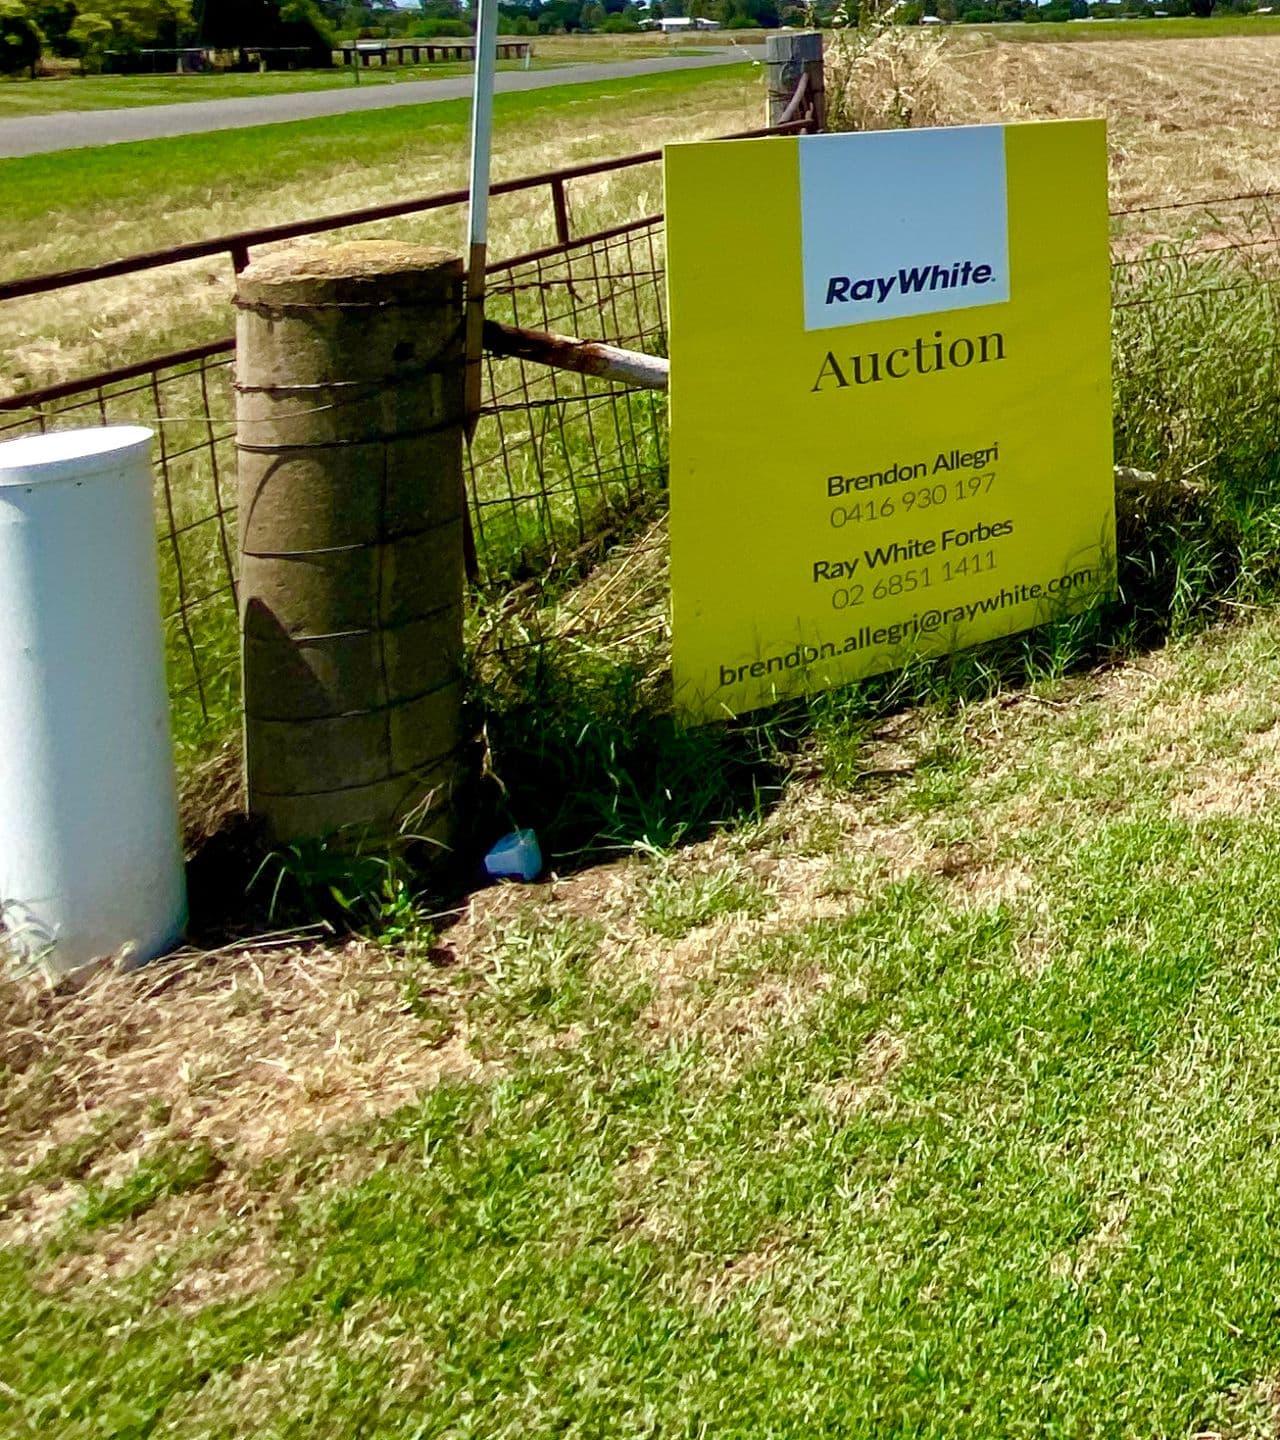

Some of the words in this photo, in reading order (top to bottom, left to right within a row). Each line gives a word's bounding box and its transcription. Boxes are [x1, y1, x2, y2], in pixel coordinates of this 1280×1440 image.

[811, 331, 1006, 392] Auction
[828, 463, 927, 497] Brendon
[932, 442, 999, 474] Allegri
[830, 497, 895, 528] 0416
[902, 484, 947, 512] 930
[955, 472, 996, 500] 197
[813, 558, 859, 583] Ray
[864, 539, 936, 569] White
[942, 520, 1014, 551] Forbes
[832, 584, 865, 610] 02
[873, 567, 931, 600] 6851
[943, 550, 997, 582] 1411
[719, 567, 1092, 687] brendon.allegri@raywhite.com
